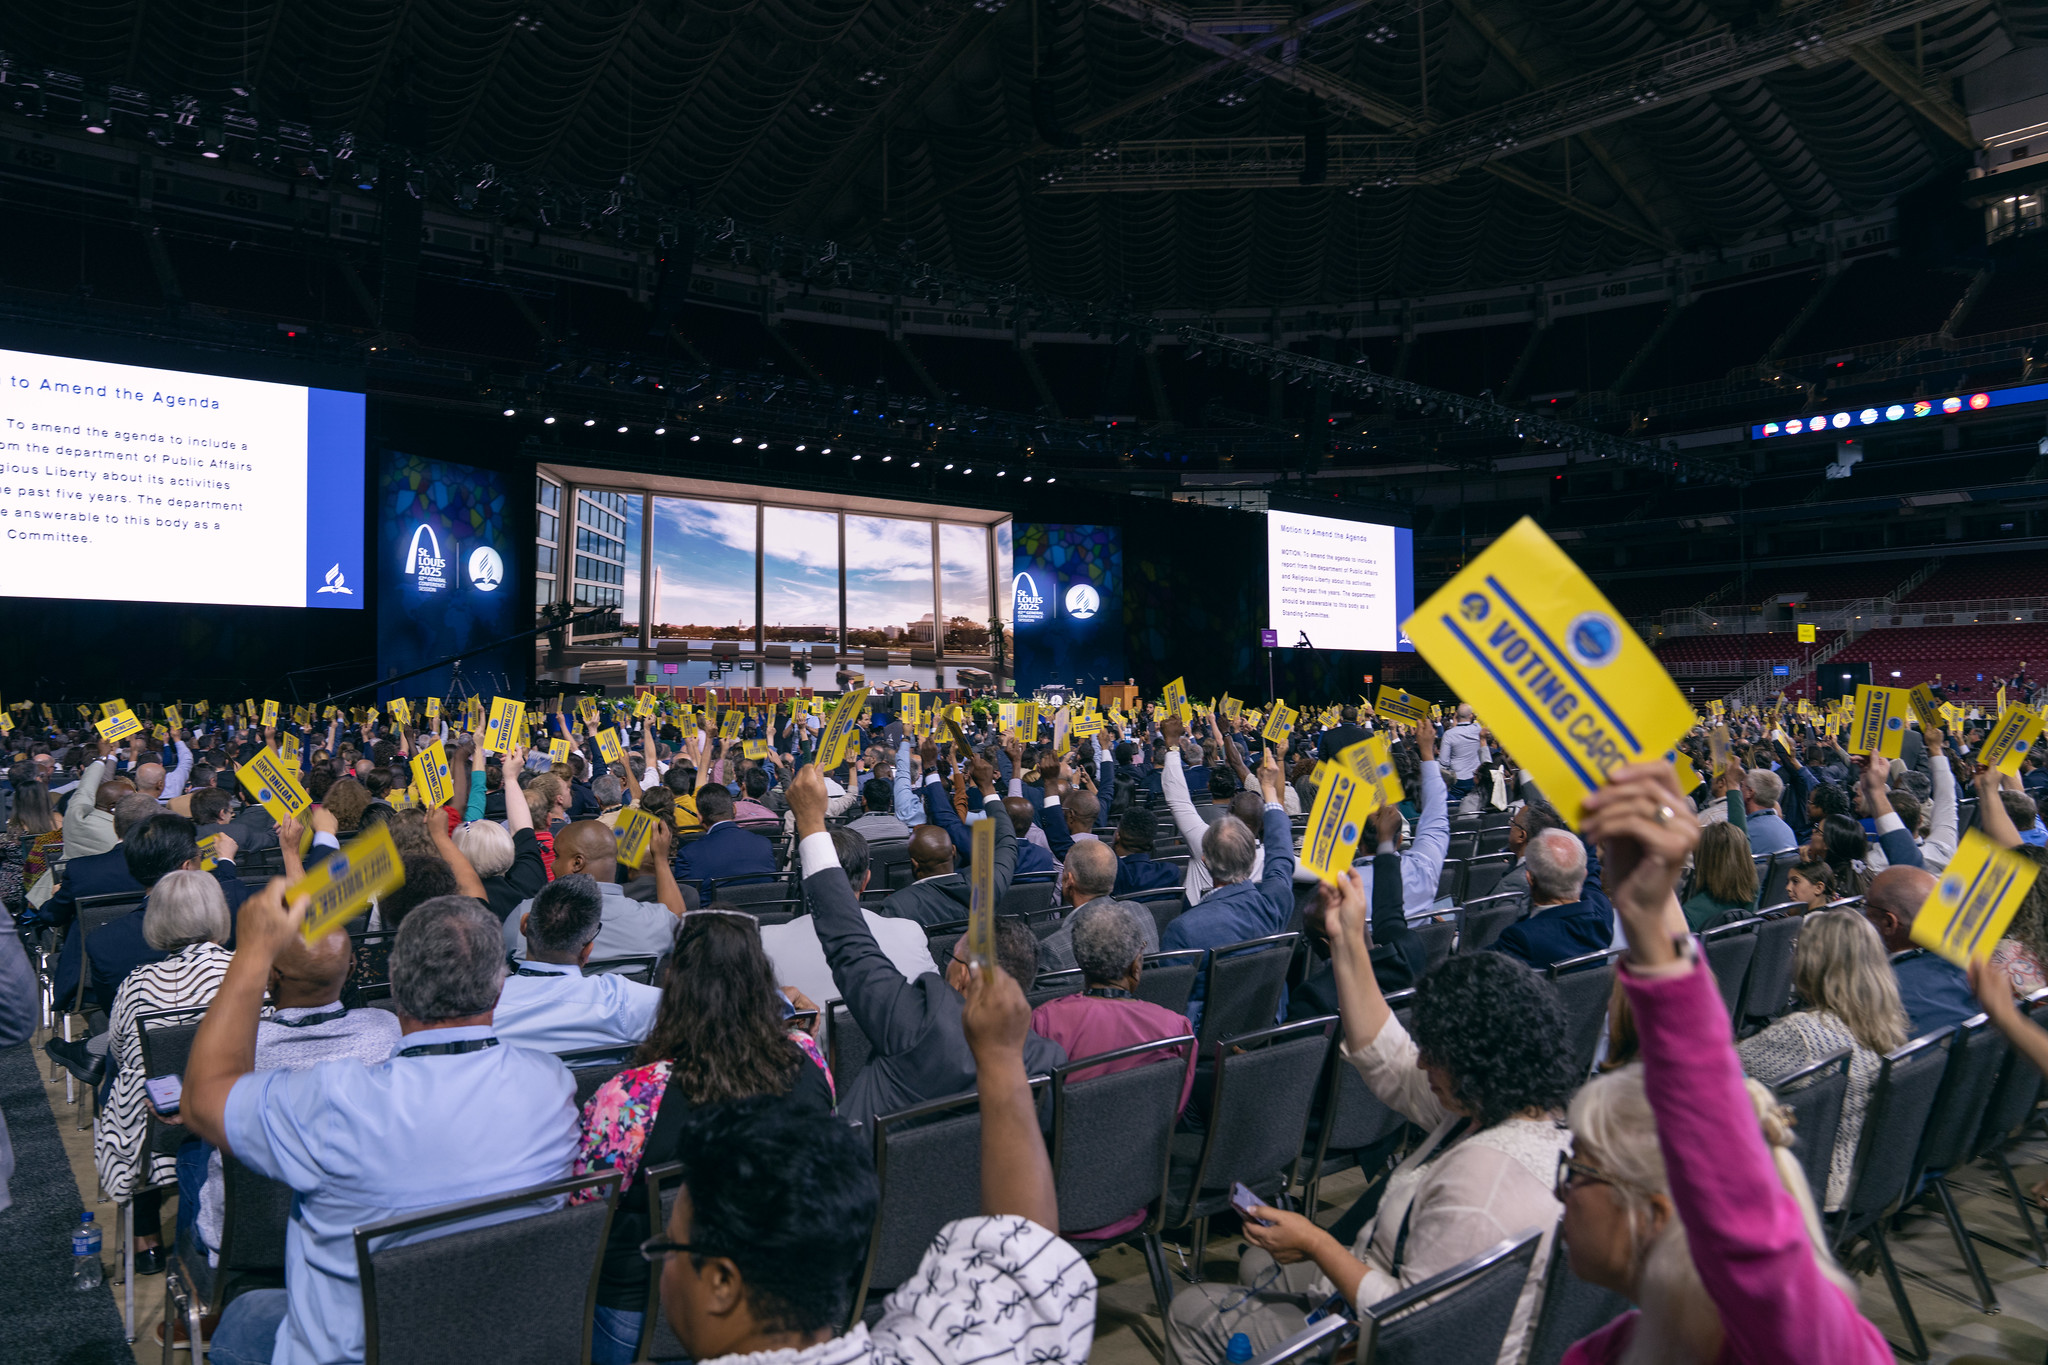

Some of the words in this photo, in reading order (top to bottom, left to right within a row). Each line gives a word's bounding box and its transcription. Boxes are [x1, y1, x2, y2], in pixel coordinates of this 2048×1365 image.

[225, 189, 257, 209] 453
[1601, 283, 1626, 298] 409
[1463, 303, 1488, 317] 408
[947, 314, 969, 327] 404
[11, 376, 29, 388] to
[40, 379, 107, 397] Amend
[115, 388, 144, 401] the
[152, 392, 220, 409] Agenda
[6, 418, 25, 430] To
[31, 423, 81, 435] amend
[87, 427, 109, 437] the
[114, 431, 165, 442] agenda
[170, 436, 183, 445] to
[189, 436, 236, 450] include
[241, 443, 248, 451] a
[26, 443, 50, 454] the
[55, 446, 138, 461] department
[143, 454, 157, 463] of
[162, 454, 204, 468] Public
[210, 459, 253, 472] Affairs
[46, 465, 97, 481] Liberty
[103, 471, 142, 483] about
[148, 474, 165, 485] its
[170, 477, 231, 490] activities
[18, 488, 50, 498] past
[56, 488, 83, 500] five
[88, 493, 132, 503] years.
[137, 494, 162, 506] The
[167, 497, 243, 511] department
[15, 509, 100, 523] answerable
[105, 515, 119, 524] to
[125, 515, 150, 526] this
[155, 517, 189, 531] body
[194, 521, 209, 530] as
[213, 522, 221, 530] a
[7, 529, 93, 543] Committee.
[1281, 524, 1302, 534] Motion
[1312, 529, 1333, 538] Amend
[1334, 532, 1344, 540] the
[1346, 533, 1367, 542] Agenda
[418, 557, 446, 568] LOUIS
[418, 566, 442, 577] 2025
[1317, 565, 1343, 573] department
[1292, 574, 1314, 582] Religious
[1017, 596, 1043, 604] LOUIS
[1282, 586, 1298, 594] during
[1351, 591, 1376, 599] department
[1017, 603, 1040, 611] 2025
[1282, 609, 1303, 618] Standing
[1487, 619, 1579, 723] VOTING
[505, 703, 514, 717] CARD
[1869, 702, 1880, 732] VOTING
[109, 724, 126, 735] VOTING
[501, 717, 511, 741] VOTING
[828, 707, 849, 745] VOTING
[1274, 713, 1284, 729] VOTING
[1999, 721, 2018, 745] VOTING
[1991, 743, 2003, 758] CAR
[255, 758, 272, 778] CARD
[425, 760, 437, 790] VOTING
[270, 775, 293, 803] VOTING
[1323, 795, 1344, 839] VOTING
